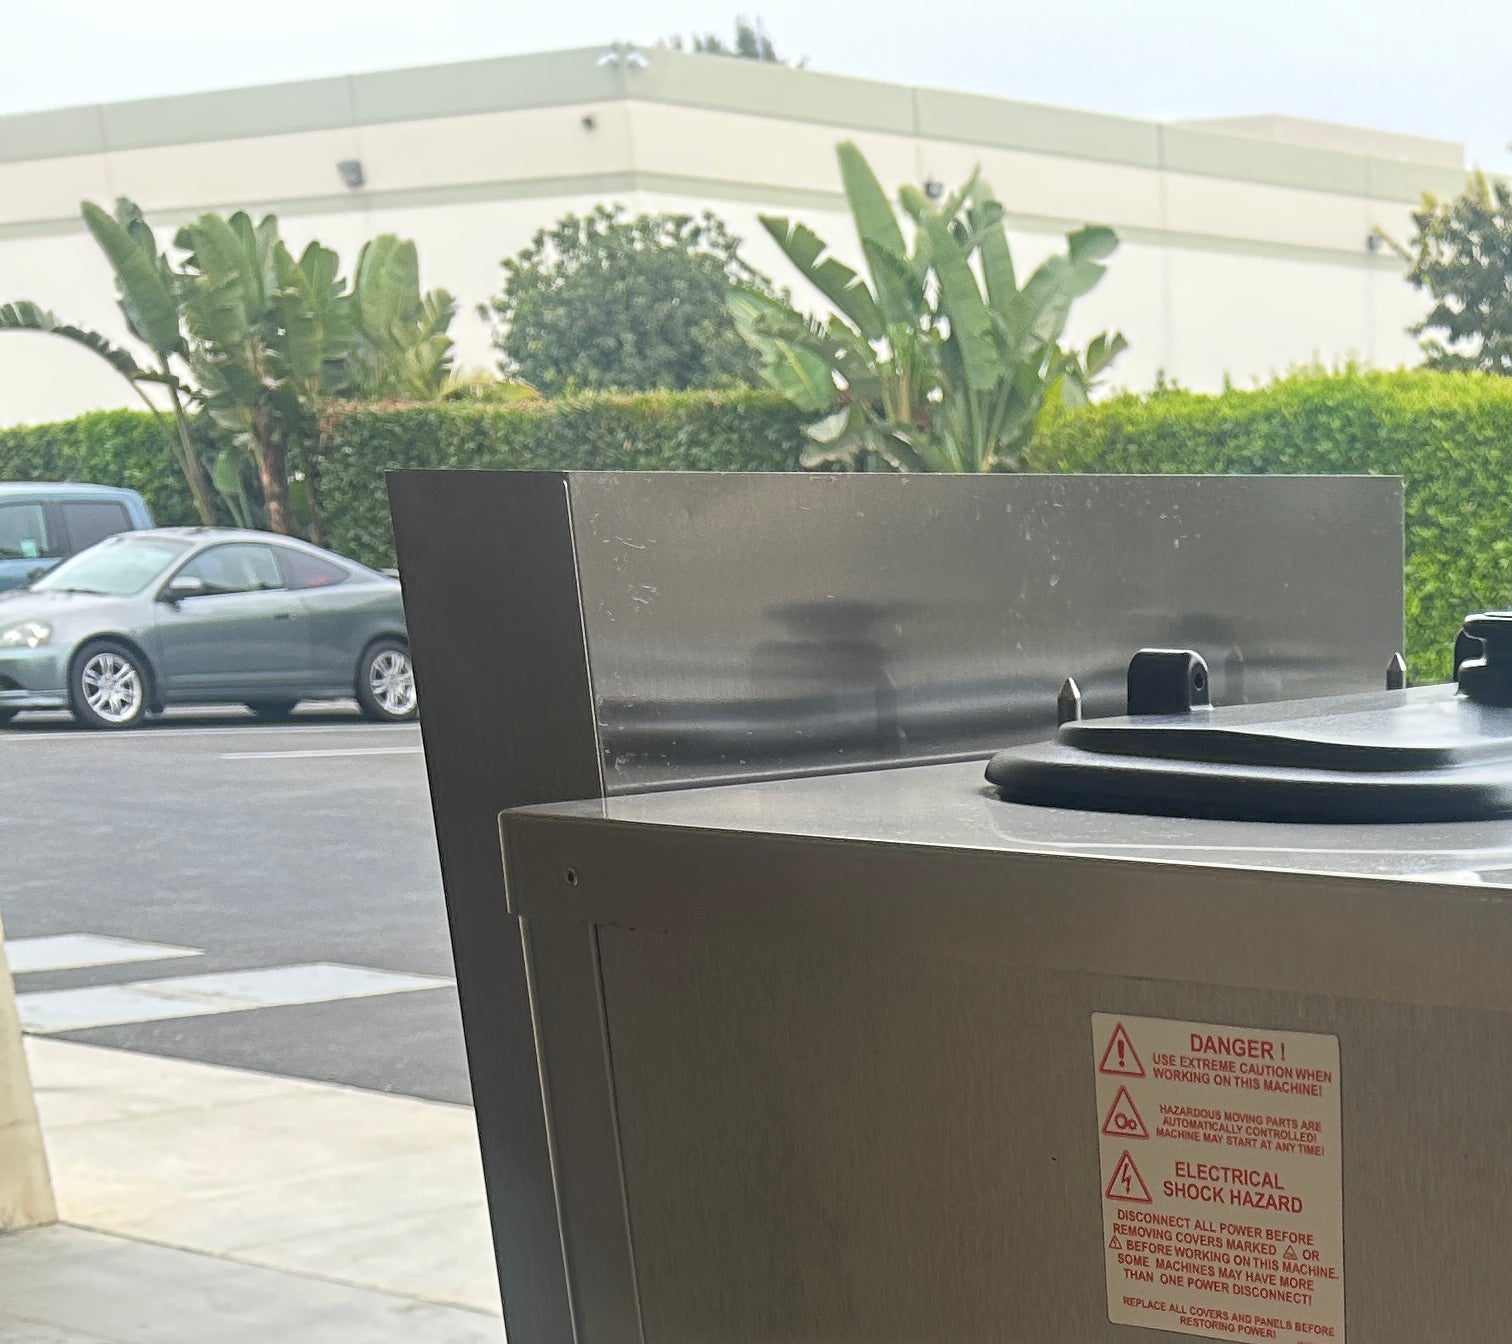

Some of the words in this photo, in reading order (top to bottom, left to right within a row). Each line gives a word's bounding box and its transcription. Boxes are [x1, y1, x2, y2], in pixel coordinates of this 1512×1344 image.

[1190, 1033, 1274, 1060] DANGER
[1152, 1053, 1177, 1067] USE
[1180, 1056, 1236, 1073] EXTREME
[1239, 1062, 1293, 1078] CAUTION
[1295, 1067, 1332, 1084] WHEN
[1152, 1067, 1211, 1084] WORKING
[1214, 1074, 1231, 1086] ON
[1234, 1076, 1260, 1089] THIS
[1263, 1079, 1323, 1097] MACHINE!
[1159, 1104, 1222, 1120] HAZARDOUS
[1224, 1111, 1264, 1125] MOVING
[1266, 1116, 1298, 1129] PARTS
[1301, 1120, 1322, 1132] ARE
[1162, 1116, 1243, 1134] AUTOMATICALLY
[1245, 1126, 1317, 1143] CONTROLLED!
[1156, 1126, 1200, 1141] MACHINE
[1203, 1132, 1223, 1144] MAY
[1225, 1135, 1257, 1149] START
[1260, 1139, 1272, 1150] AT
[1275, 1140, 1296, 1153] ANY
[1299, 1143, 1325, 1157] TIME!
[1175, 1159, 1285, 1190] ELECTRICAL
[1163, 1180, 1225, 1204] SHOCK
[1230, 1189, 1303, 1214] HAZARD
[1112, 1222, 1173, 1242] REMOVING
[1175, 1231, 1223, 1249] COVERS
[1226, 1237, 1277, 1256] MARKED
[1302, 1249, 1320, 1262] OR
[1117, 1208, 1191, 1229] DISCONNECT
[1194, 1219, 1216, 1233] ALL
[1219, 1222, 1263, 1239] POWER
[1266, 1228, 1314, 1246] BEFORE
[1126, 1239, 1173, 1256] BEFORE
[1175, 1246, 1230, 1264] WORKING
[1233, 1254, 1250, 1267] ON
[1253, 1257, 1279, 1272] THIS
[1117, 1253, 1150, 1268] SOME
[1155, 1258, 1215, 1278] MACHINES
[1218, 1266, 1242, 1281] MAY
[1245, 1270, 1276, 1285] HAVE
[1279, 1276, 1314, 1291] MORE
[1123, 1267, 1154, 1283] THAN
[1160, 1274, 1184, 1287] ONE
[1187, 1277, 1230, 1294] POWER
[1232, 1284, 1312, 1306] DISCONNECT!
[1123, 1296, 1166, 1312] REPLACE
[1169, 1303, 1187, 1315] ALL
[1189, 1306, 1229, 1322] COVERS
[1231, 1312, 1251, 1325] AND
[1254, 1315, 1292, 1331] PANELS
[1294, 1321, 1335, 1337] BEFORE
[1179, 1315, 1235, 1333] RESTORING
[1238, 1324, 1276, 1339] POWER!
